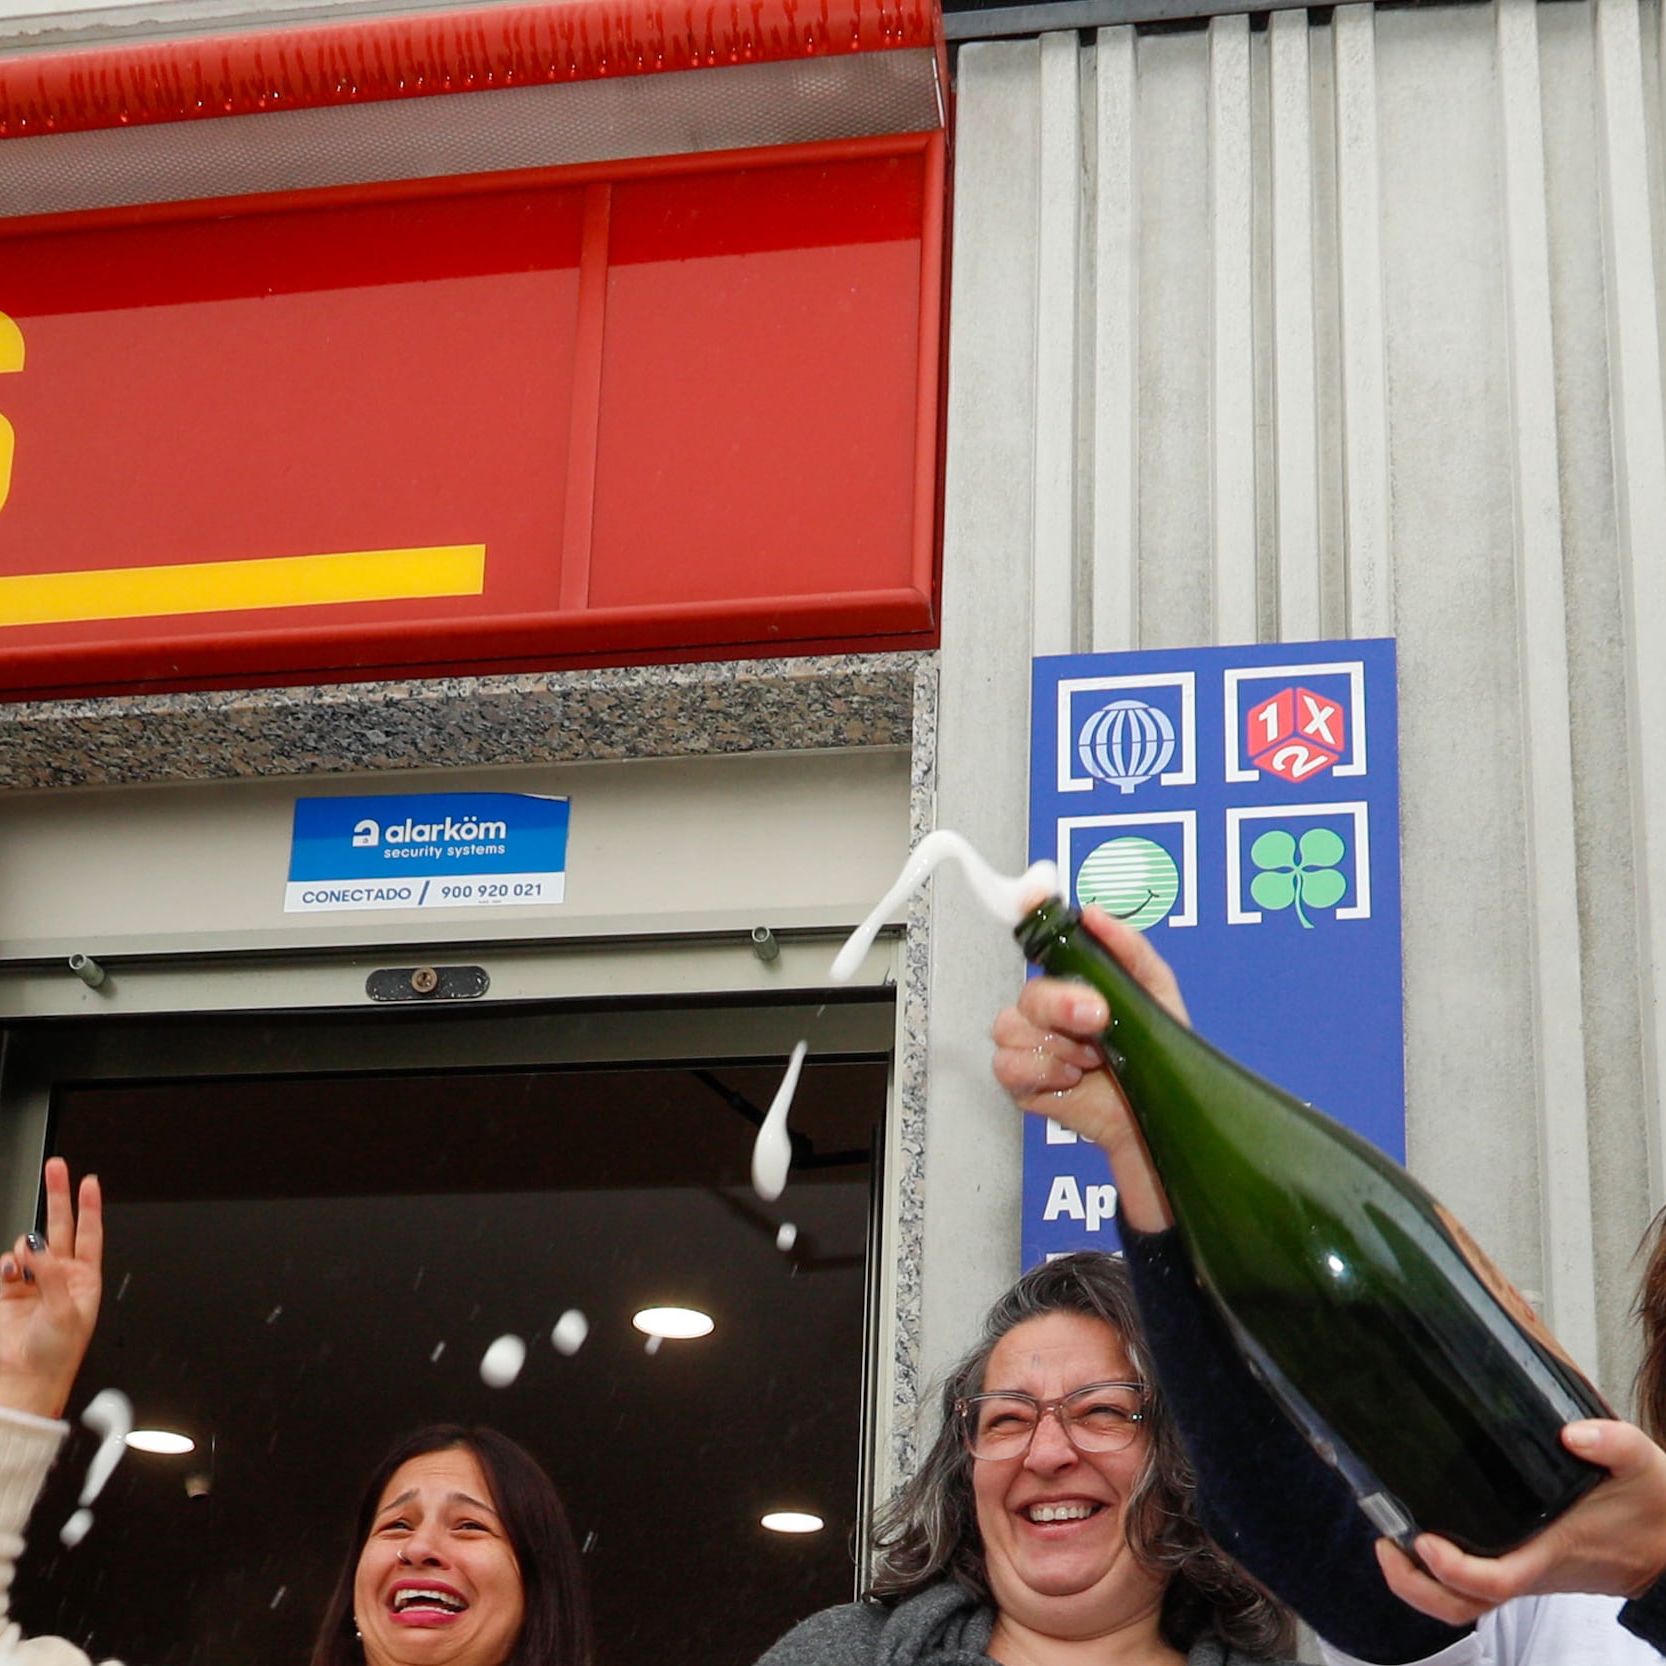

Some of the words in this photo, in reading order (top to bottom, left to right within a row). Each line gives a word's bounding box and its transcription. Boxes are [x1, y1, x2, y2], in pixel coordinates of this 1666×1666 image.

[385, 816, 507, 843] alarköm
[384, 844, 442, 859] security
[447, 843, 506, 858] systems
[302, 887, 412, 904] CONECTADO
[441, 885, 472, 899] 900
[477, 884, 509, 898] 920
[513, 883, 542, 897] 021
